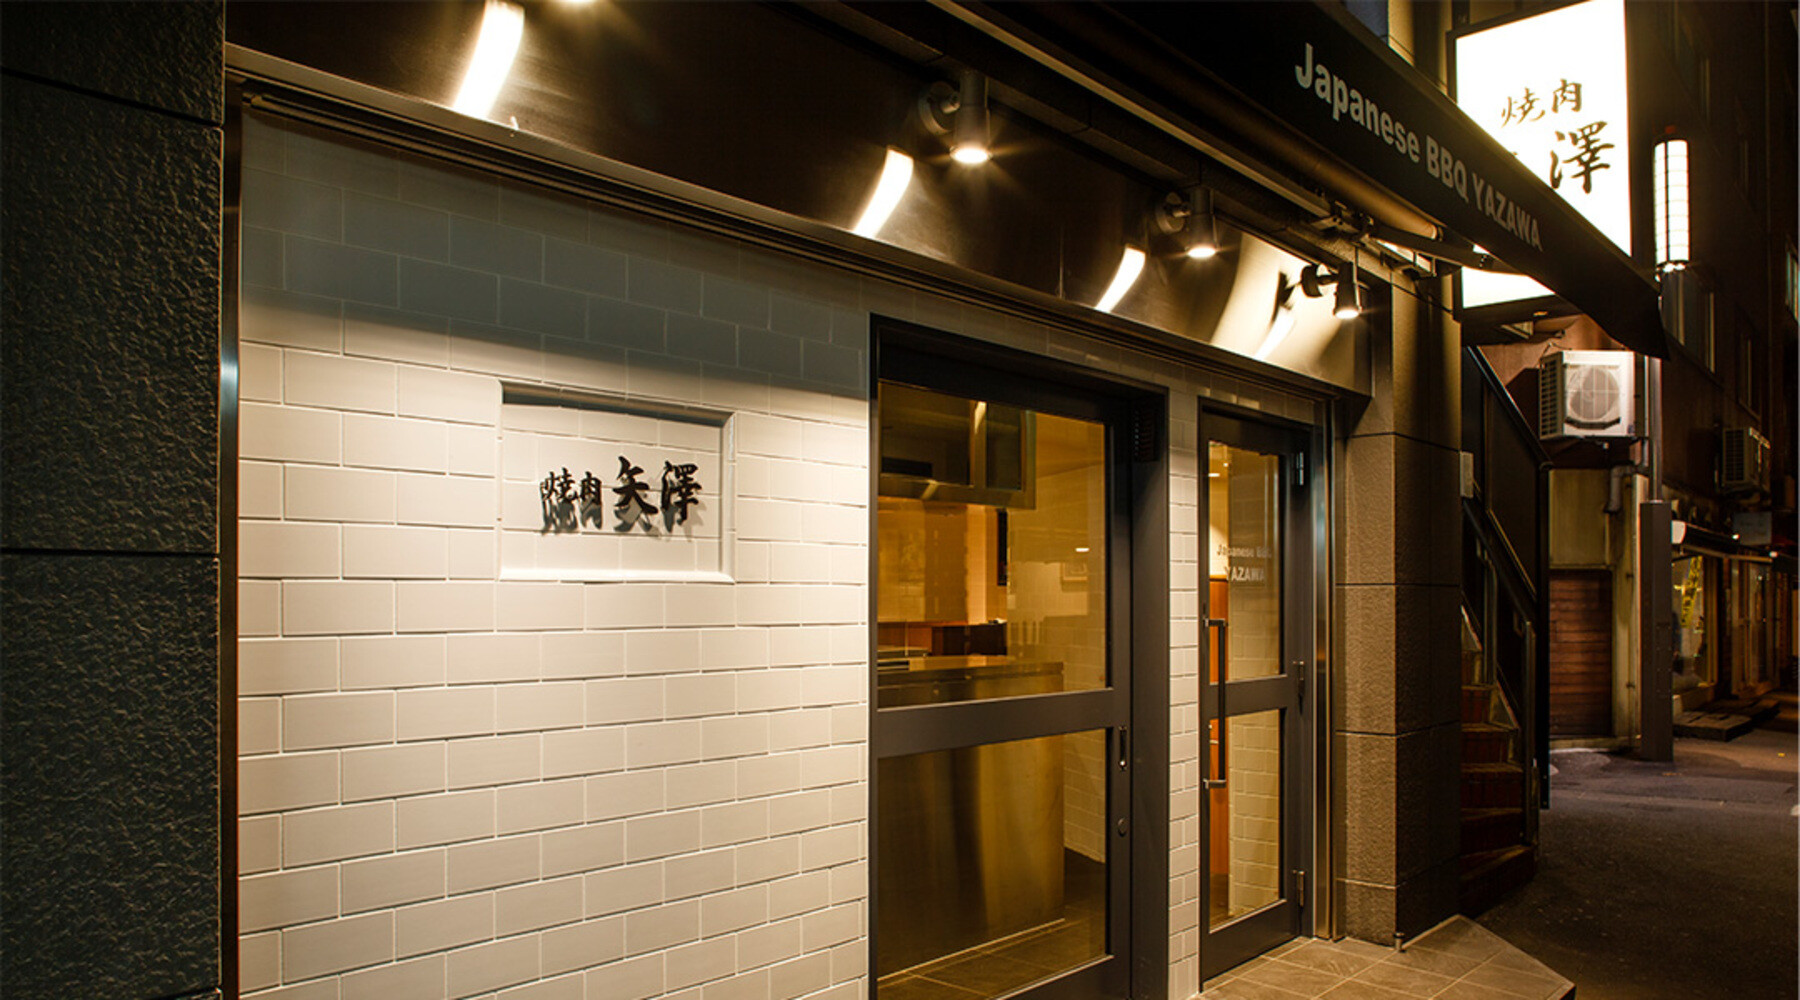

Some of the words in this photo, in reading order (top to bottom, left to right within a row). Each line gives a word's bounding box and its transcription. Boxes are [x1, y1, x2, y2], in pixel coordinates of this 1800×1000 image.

[1501, 78, 1582, 128] 焼肉
[1294, 42, 1420, 164] Japanese
[1426, 134, 1469, 204] BBQ
[1472, 172, 1543, 252] YAZAWA
[1550, 121, 1615, 194] 澤
[1224, 566, 1265, 582] YAZAWA
